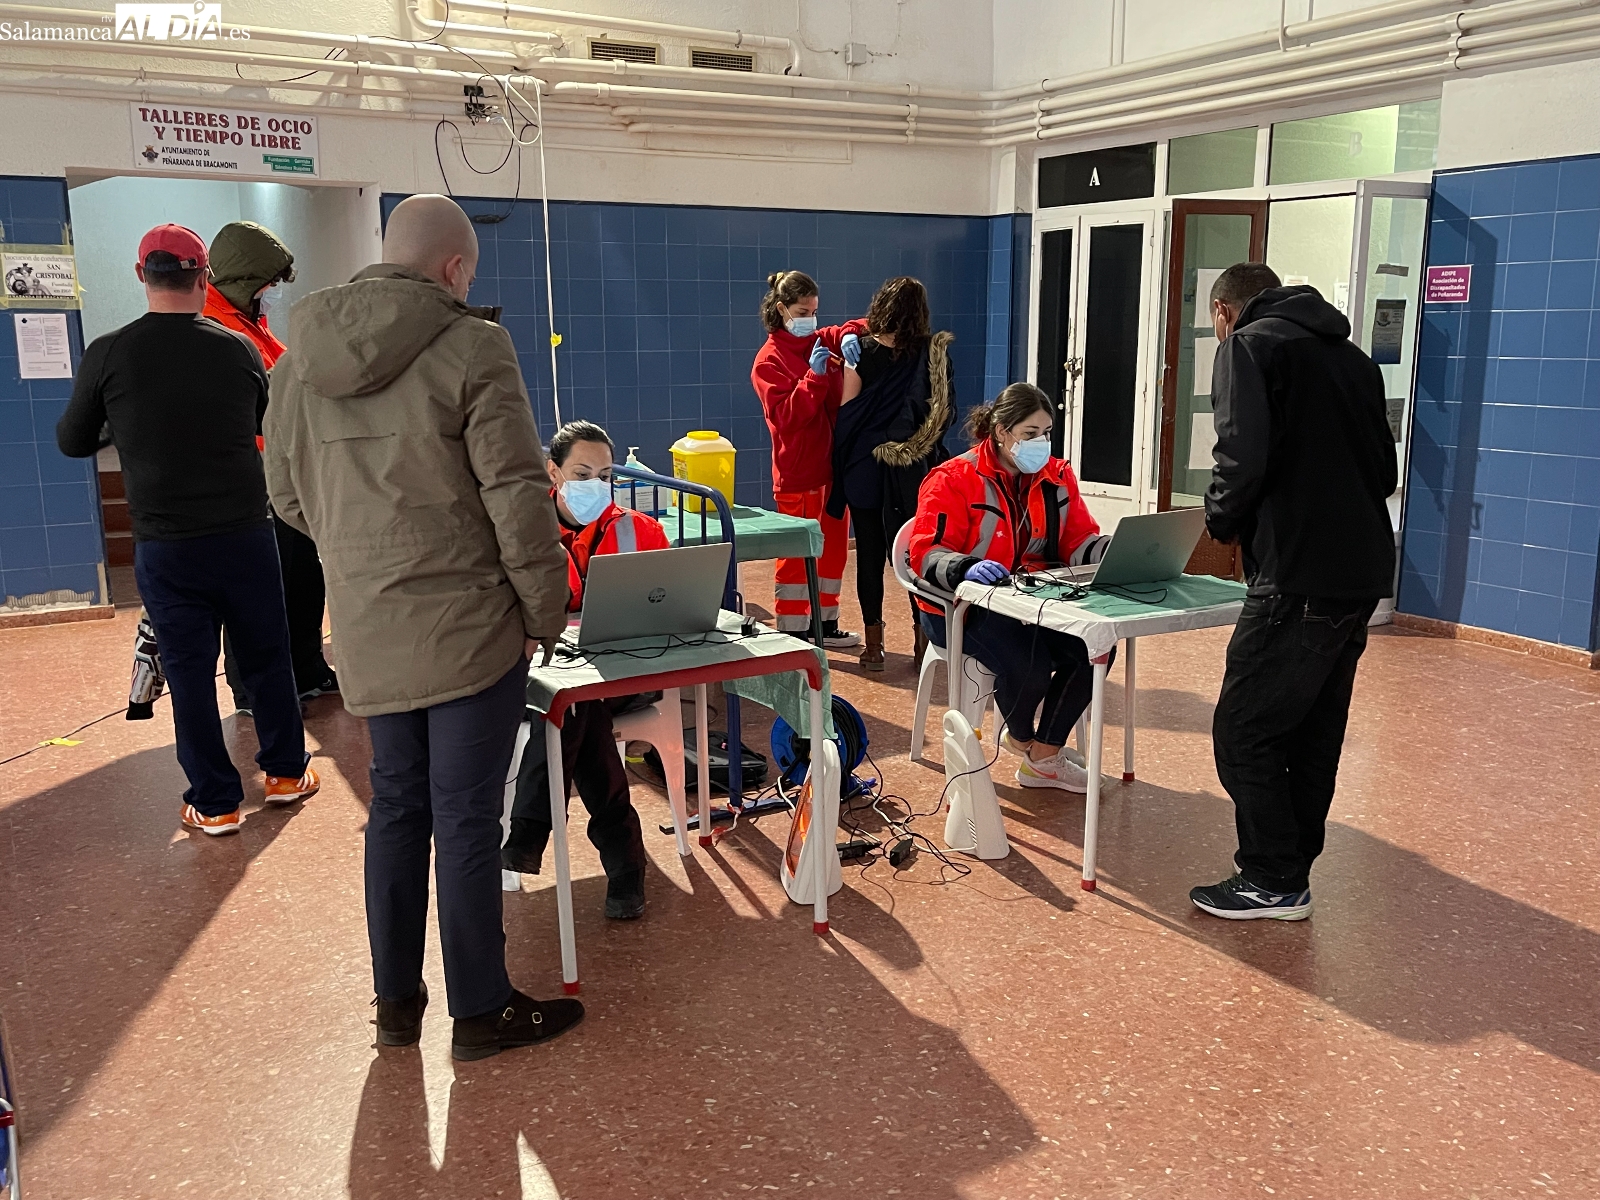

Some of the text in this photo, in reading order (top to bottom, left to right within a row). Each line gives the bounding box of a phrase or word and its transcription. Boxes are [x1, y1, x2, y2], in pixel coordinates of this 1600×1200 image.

[138, 107, 313, 135] TALLERES DE OCIO
[153, 125, 302, 150] Y TIEMPO LIBRE
[1349, 131, 1363, 156] B
[161, 146, 210, 157] AYUNTAMIENTO DE
[162, 156, 194, 167] PEÑARANDA
[203, 161, 238, 170] BRACAMONTE
[1089, 166, 1101, 187] A
